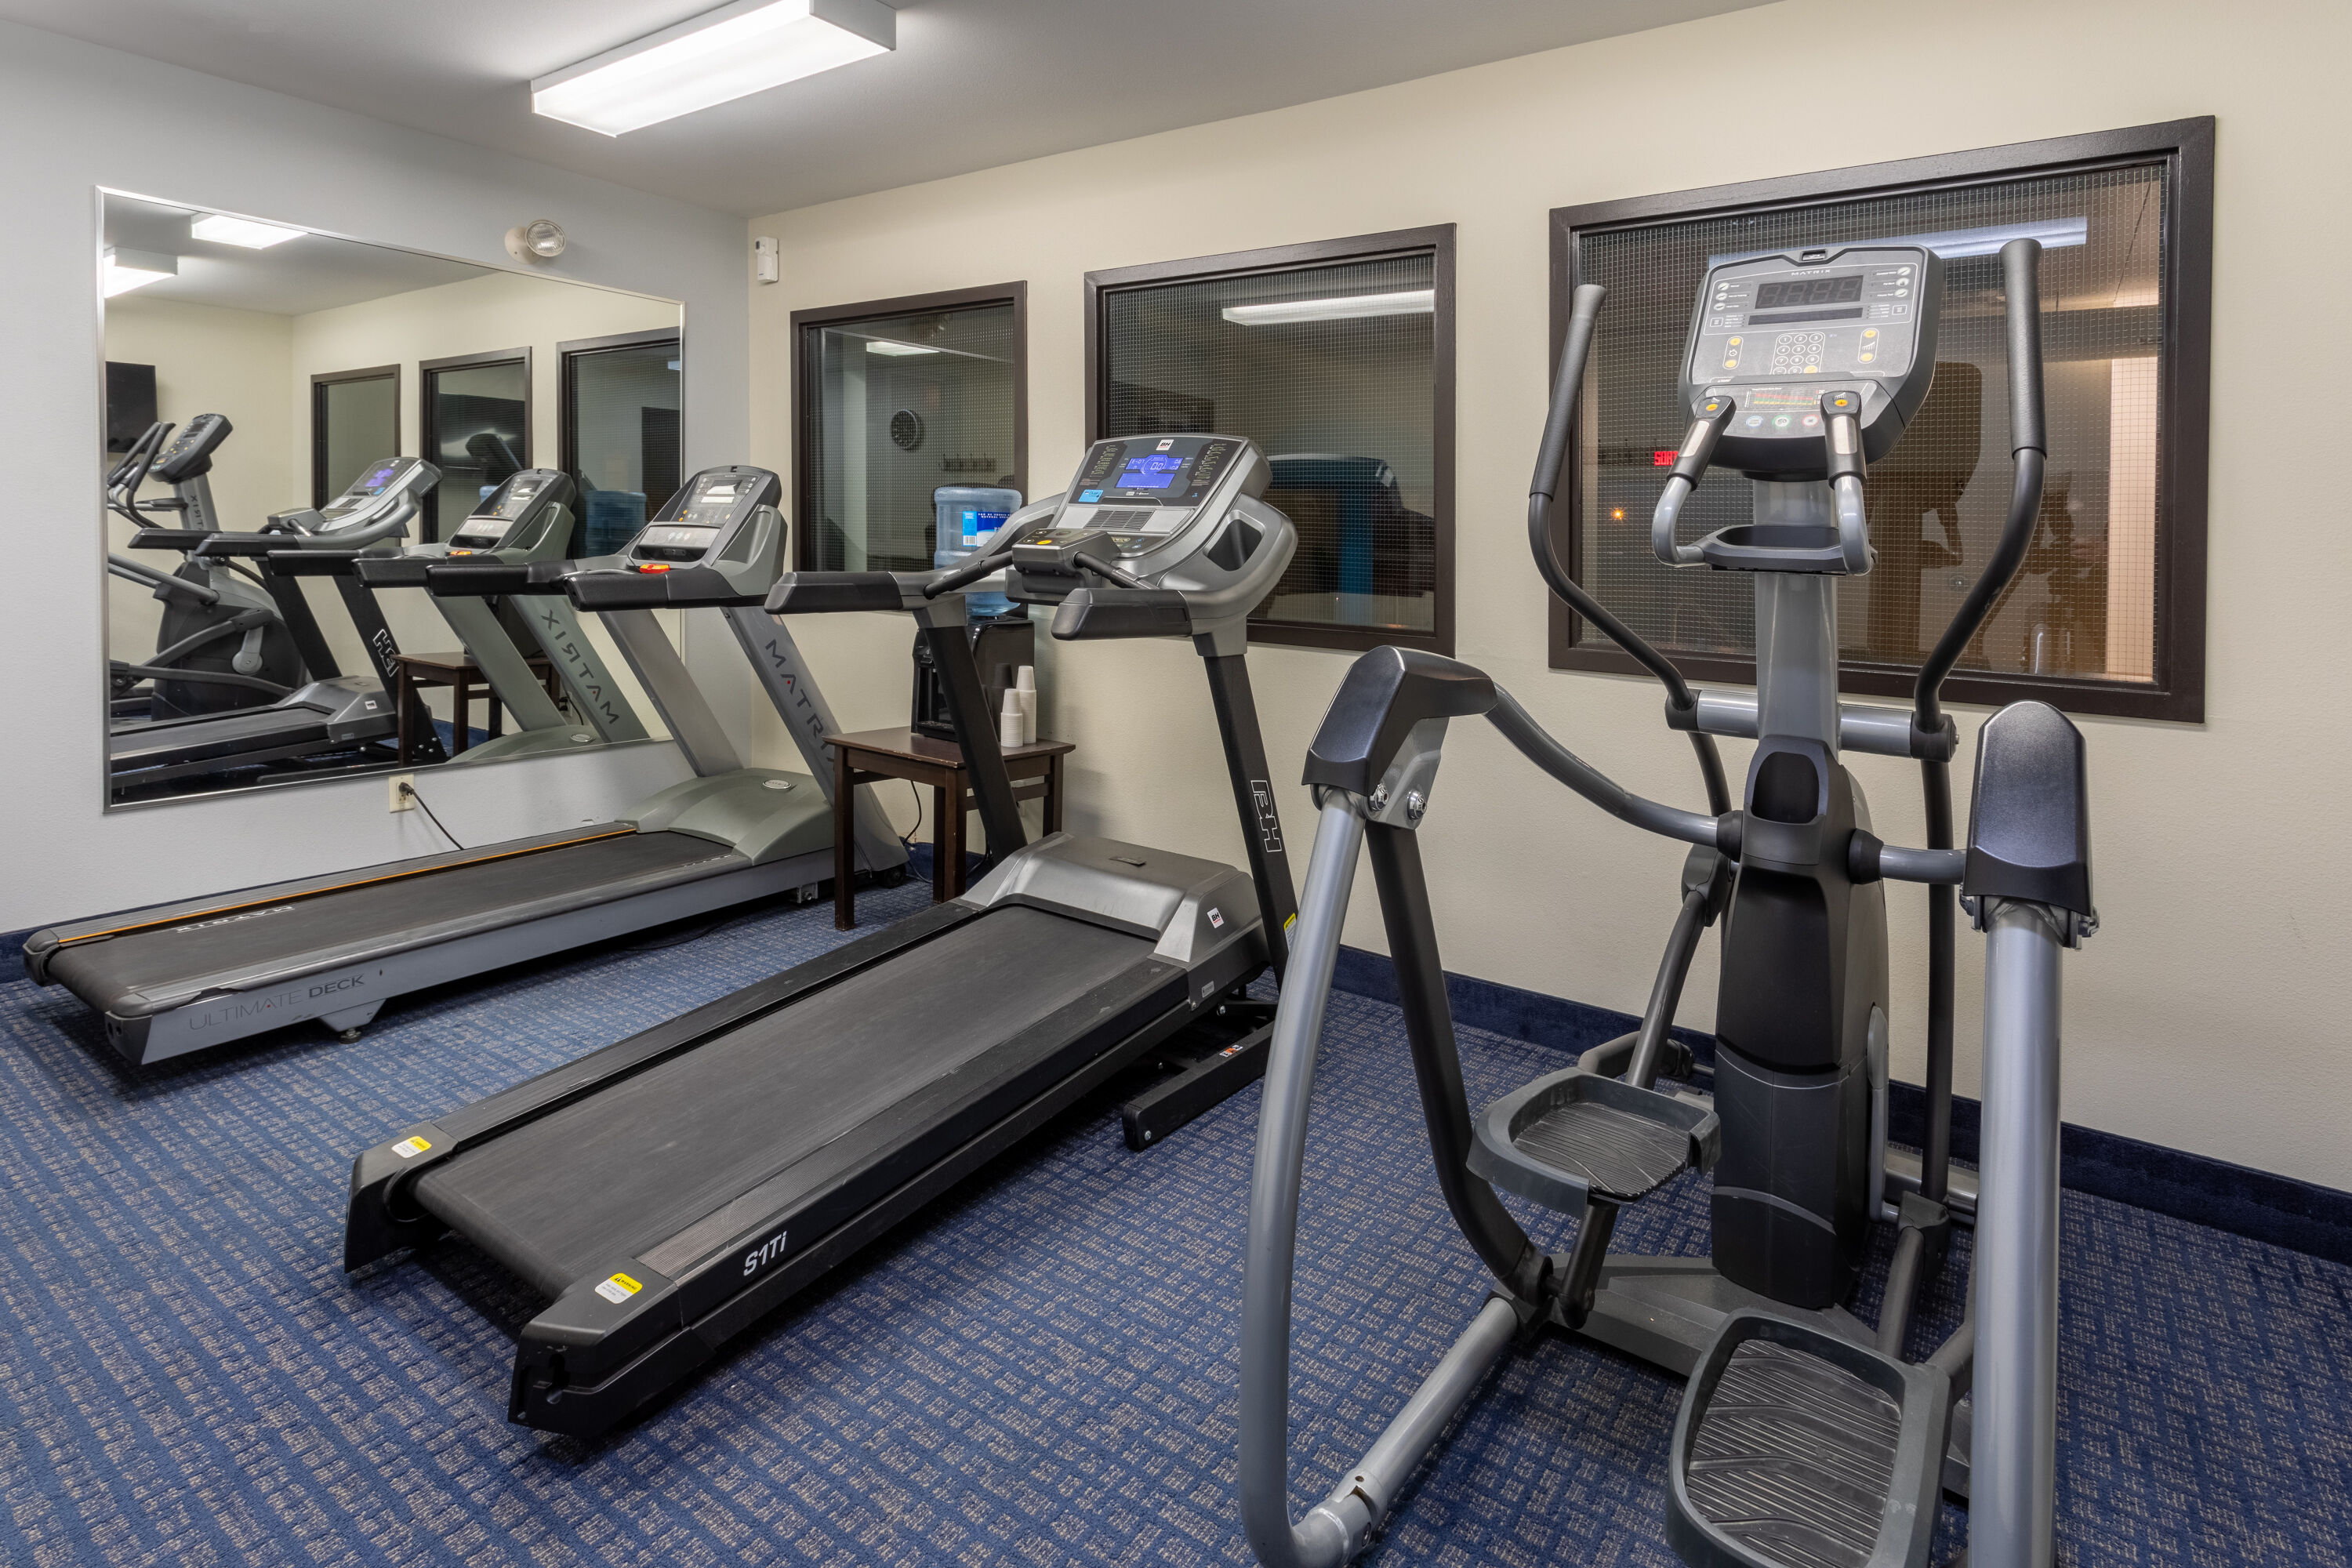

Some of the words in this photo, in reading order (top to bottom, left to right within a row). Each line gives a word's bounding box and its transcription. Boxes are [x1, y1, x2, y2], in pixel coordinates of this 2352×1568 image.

[765, 638, 835, 763] MATRI
[1250, 779, 1283, 853] BH
[1211, 912, 1221, 921] BH
[189, 990, 303, 1031] ULTIMATE
[308, 974, 365, 999] DECK
[742, 1231, 788, 1276] S1Ti
